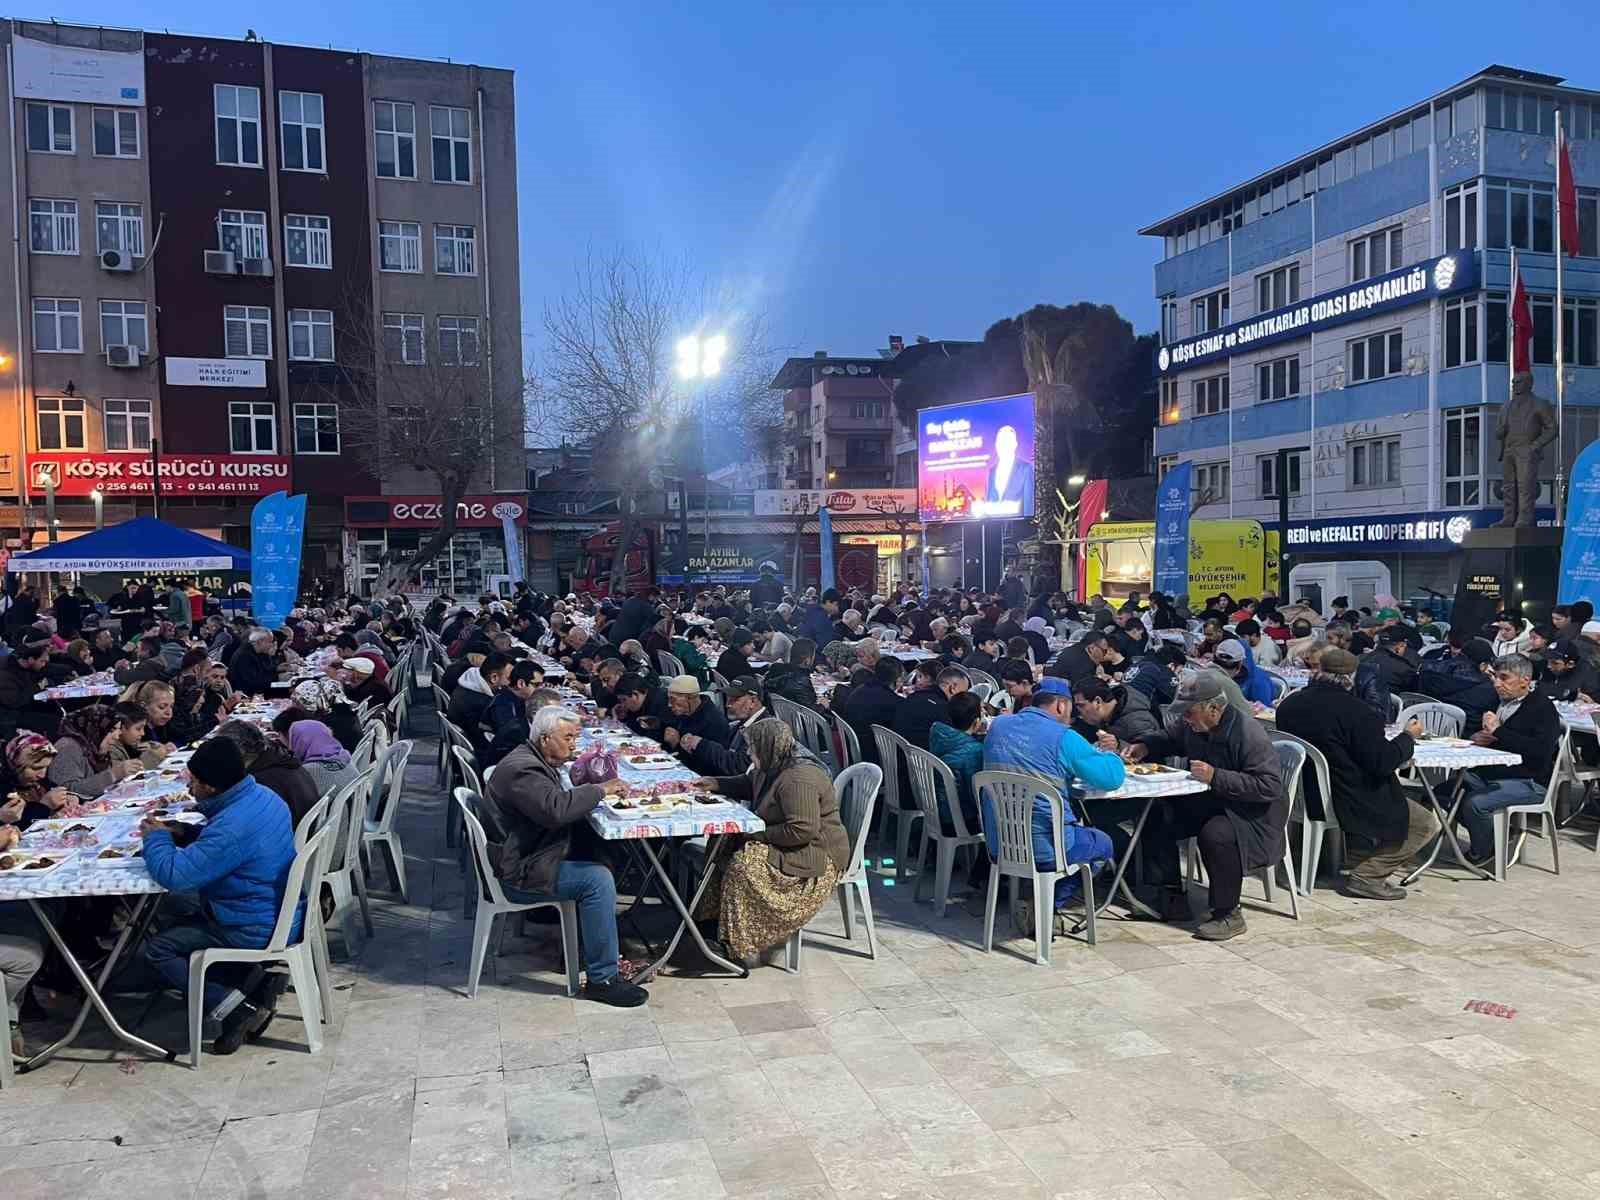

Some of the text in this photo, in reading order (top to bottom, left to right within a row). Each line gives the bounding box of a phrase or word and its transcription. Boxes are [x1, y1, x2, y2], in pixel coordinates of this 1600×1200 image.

[1172, 341, 1195, 363] KÖŞK
[1225, 332, 1237, 348] ve
[1238, 306, 1309, 344] SANATKARLAR
[1311, 298, 1347, 322] ODASI
[1349, 267, 1426, 310] BAŞKANLIĞI
[64, 458, 288, 479] KÖŞK SÜRÜCÜ KURSU
[96, 482, 104, 490] 0
[107, 482, 127, 490] 256
[129, 482, 148, 490] 461
[218, 483, 235, 491] 461
[1287, 525, 1309, 544] REDİ
[1310, 529, 1321, 543] ve
[1322, 525, 1365, 543] KEFALET
